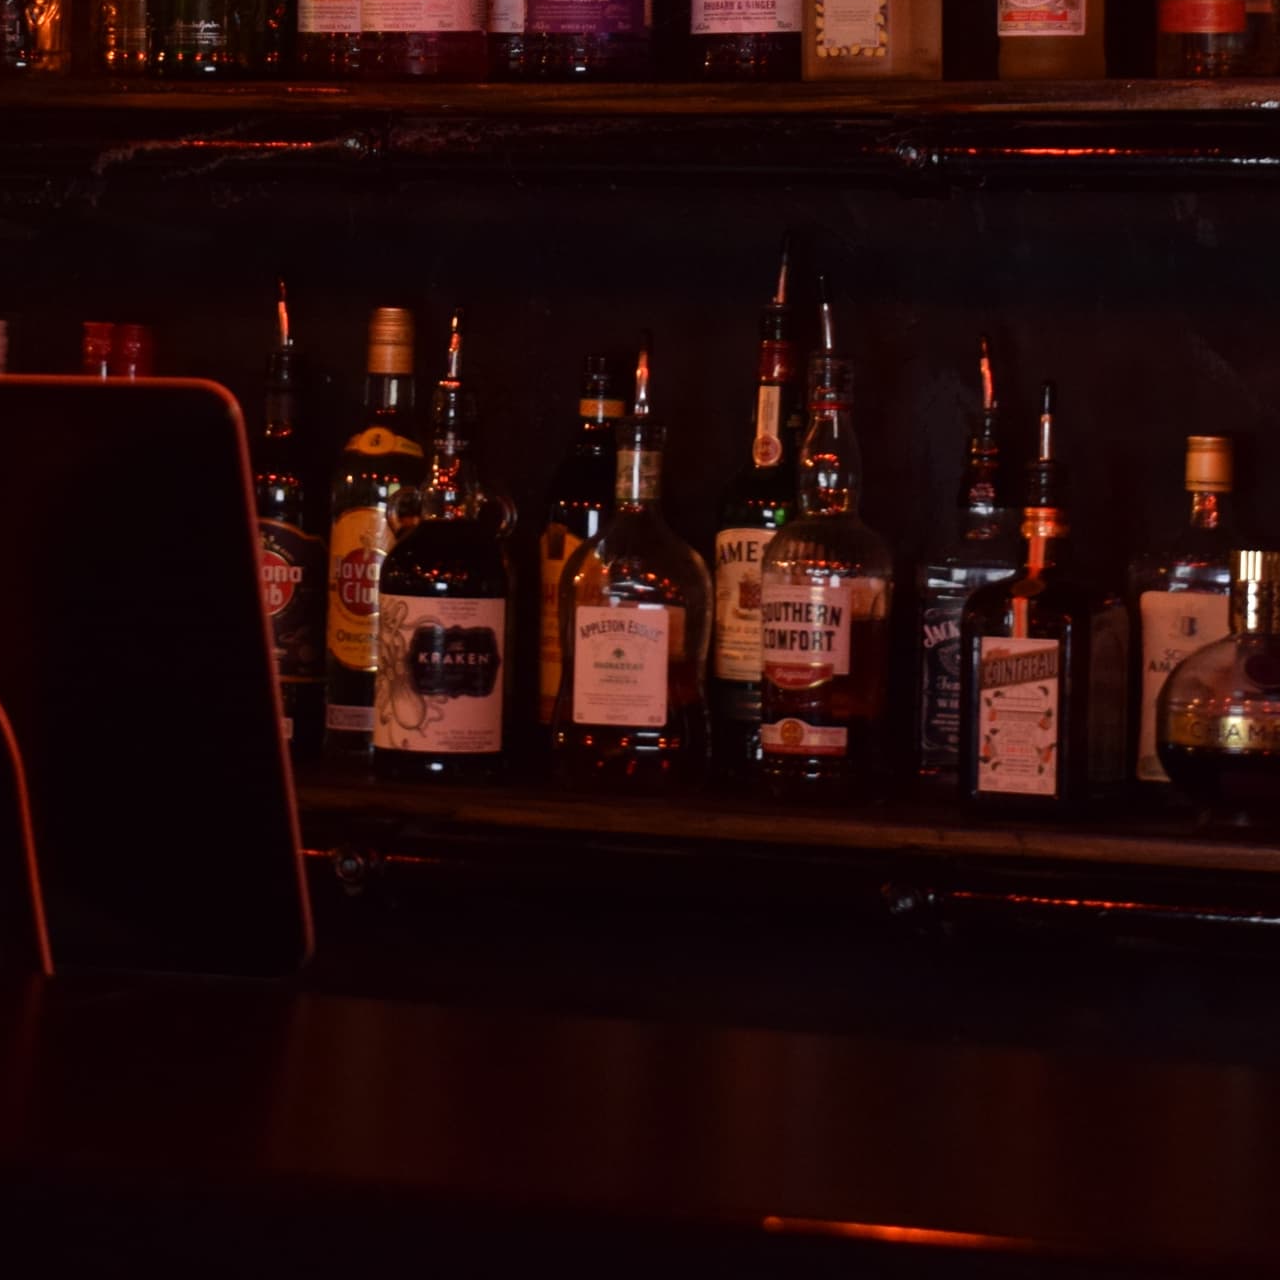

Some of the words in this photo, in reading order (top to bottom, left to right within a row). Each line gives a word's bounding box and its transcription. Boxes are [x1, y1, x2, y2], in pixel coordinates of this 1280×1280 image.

[762, 600, 843, 628] SOUTHERN
[763, 627, 836, 652] COMFORT
[417, 651, 490, 666] KRAKEN
